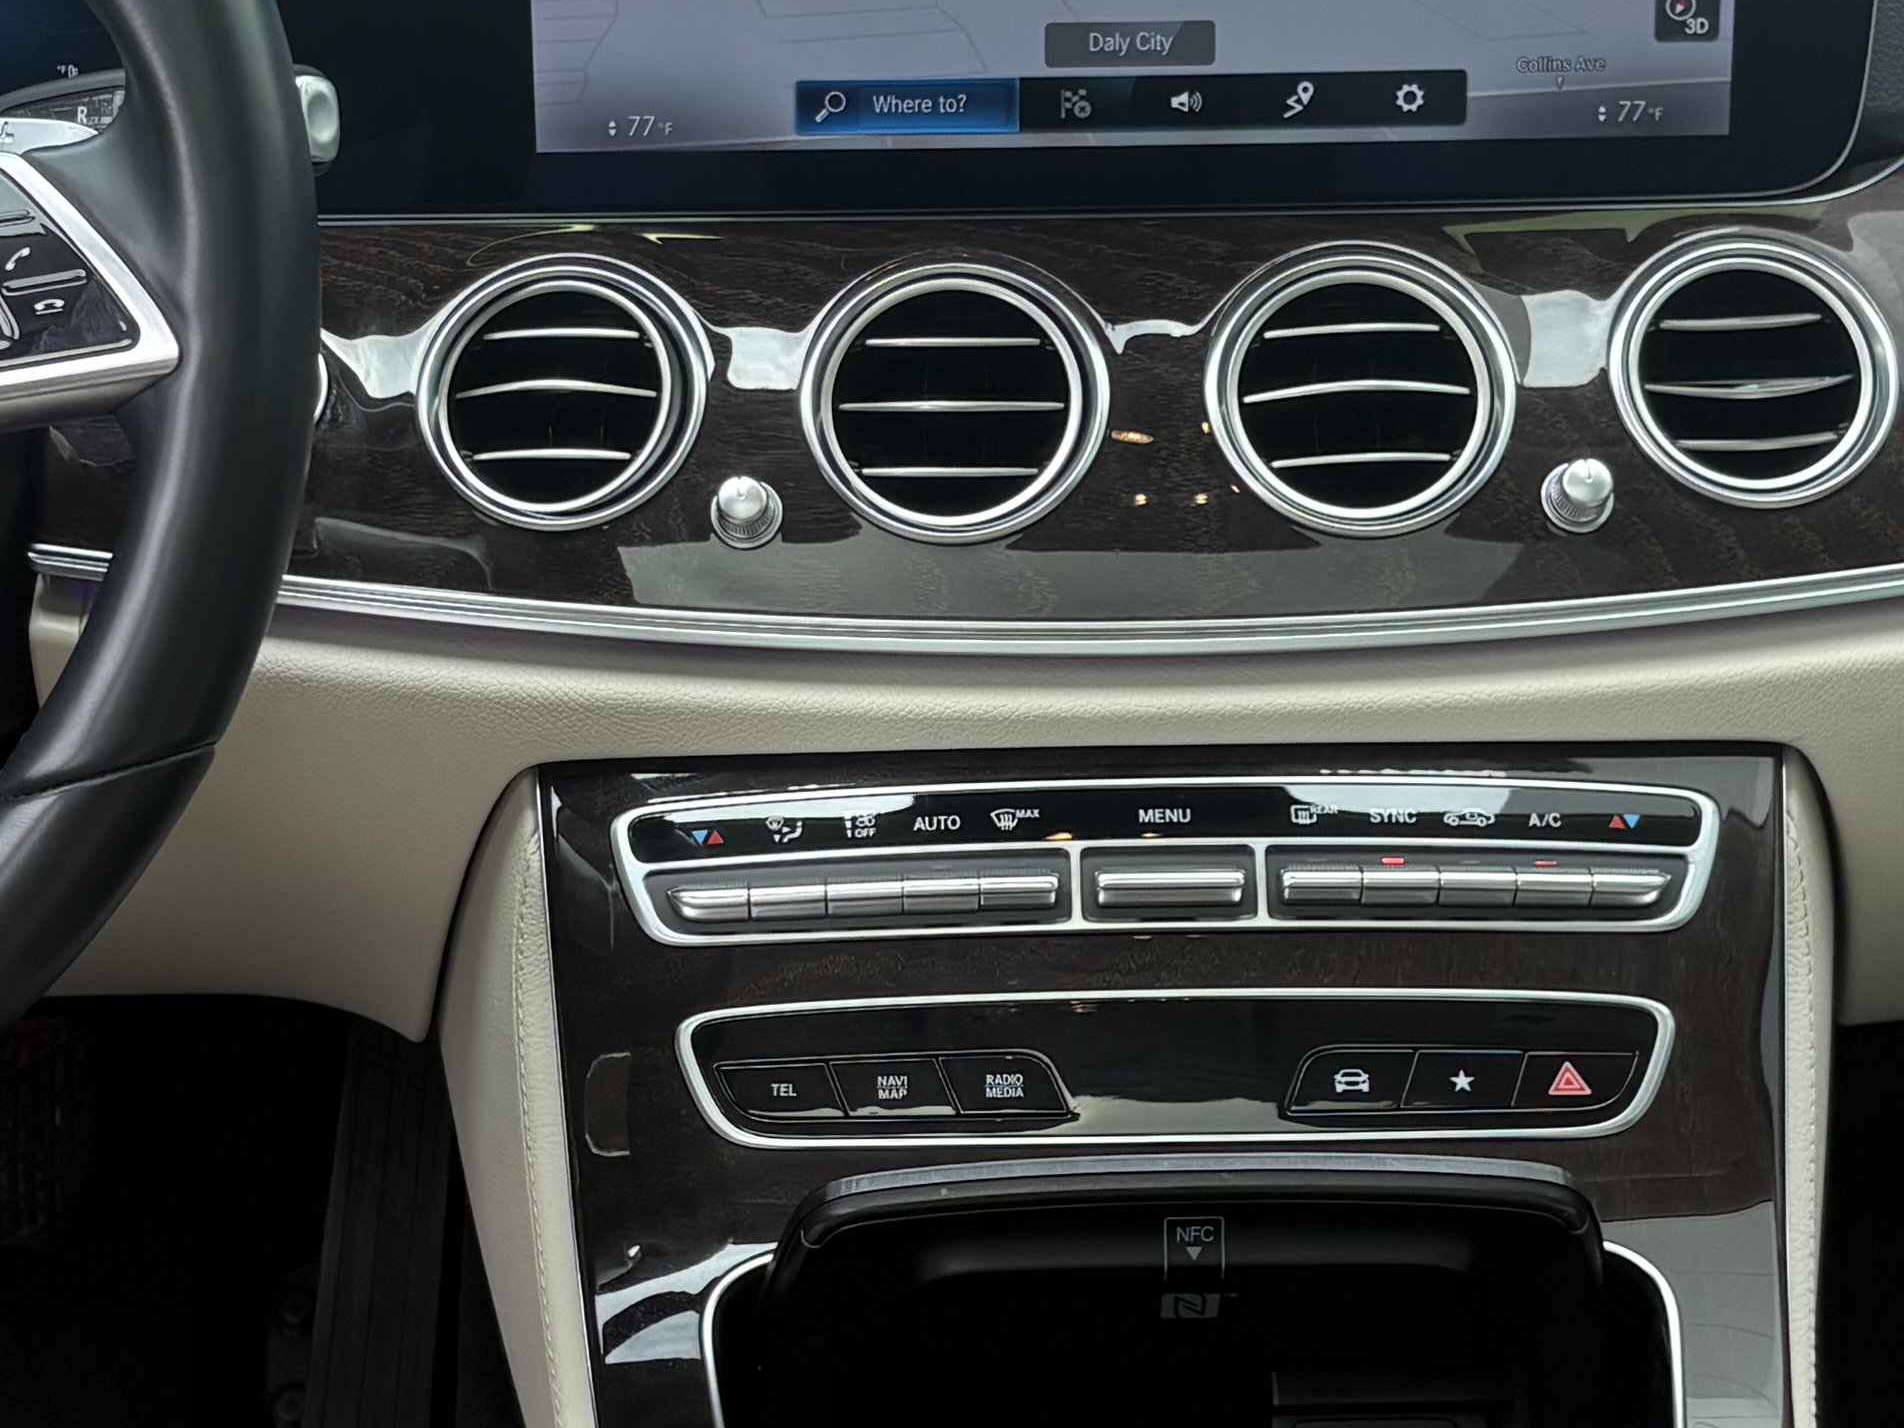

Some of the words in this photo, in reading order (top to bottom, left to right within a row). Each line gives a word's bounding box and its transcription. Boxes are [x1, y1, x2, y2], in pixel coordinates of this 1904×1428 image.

[1684, 17, 1710, 35] 3D
[1089, 32, 1130, 56] Daly
[1136, 31, 1174, 56] City
[1516, 56, 1571, 73] Collins
[1574, 56, 1607, 72] Ave
[873, 94, 933, 114] Where
[939, 94, 968, 113] to?
[1015, 808, 1041, 819] MAX
[1138, 808, 1192, 825] MENU
[1369, 808, 1418, 825] SYNC
[1528, 812, 1562, 829] A/C
[913, 814, 962, 832] AUTO
[854, 827, 876, 839] OFF
[877, 1075, 908, 1087] NAVI
[985, 1073, 1024, 1086] RADIO
[771, 1083, 797, 1097] TEL
[877, 1088, 908, 1100] MAP
[985, 1086, 1025, 1098] MEDIA
[1176, 1225, 1215, 1243] NFC
